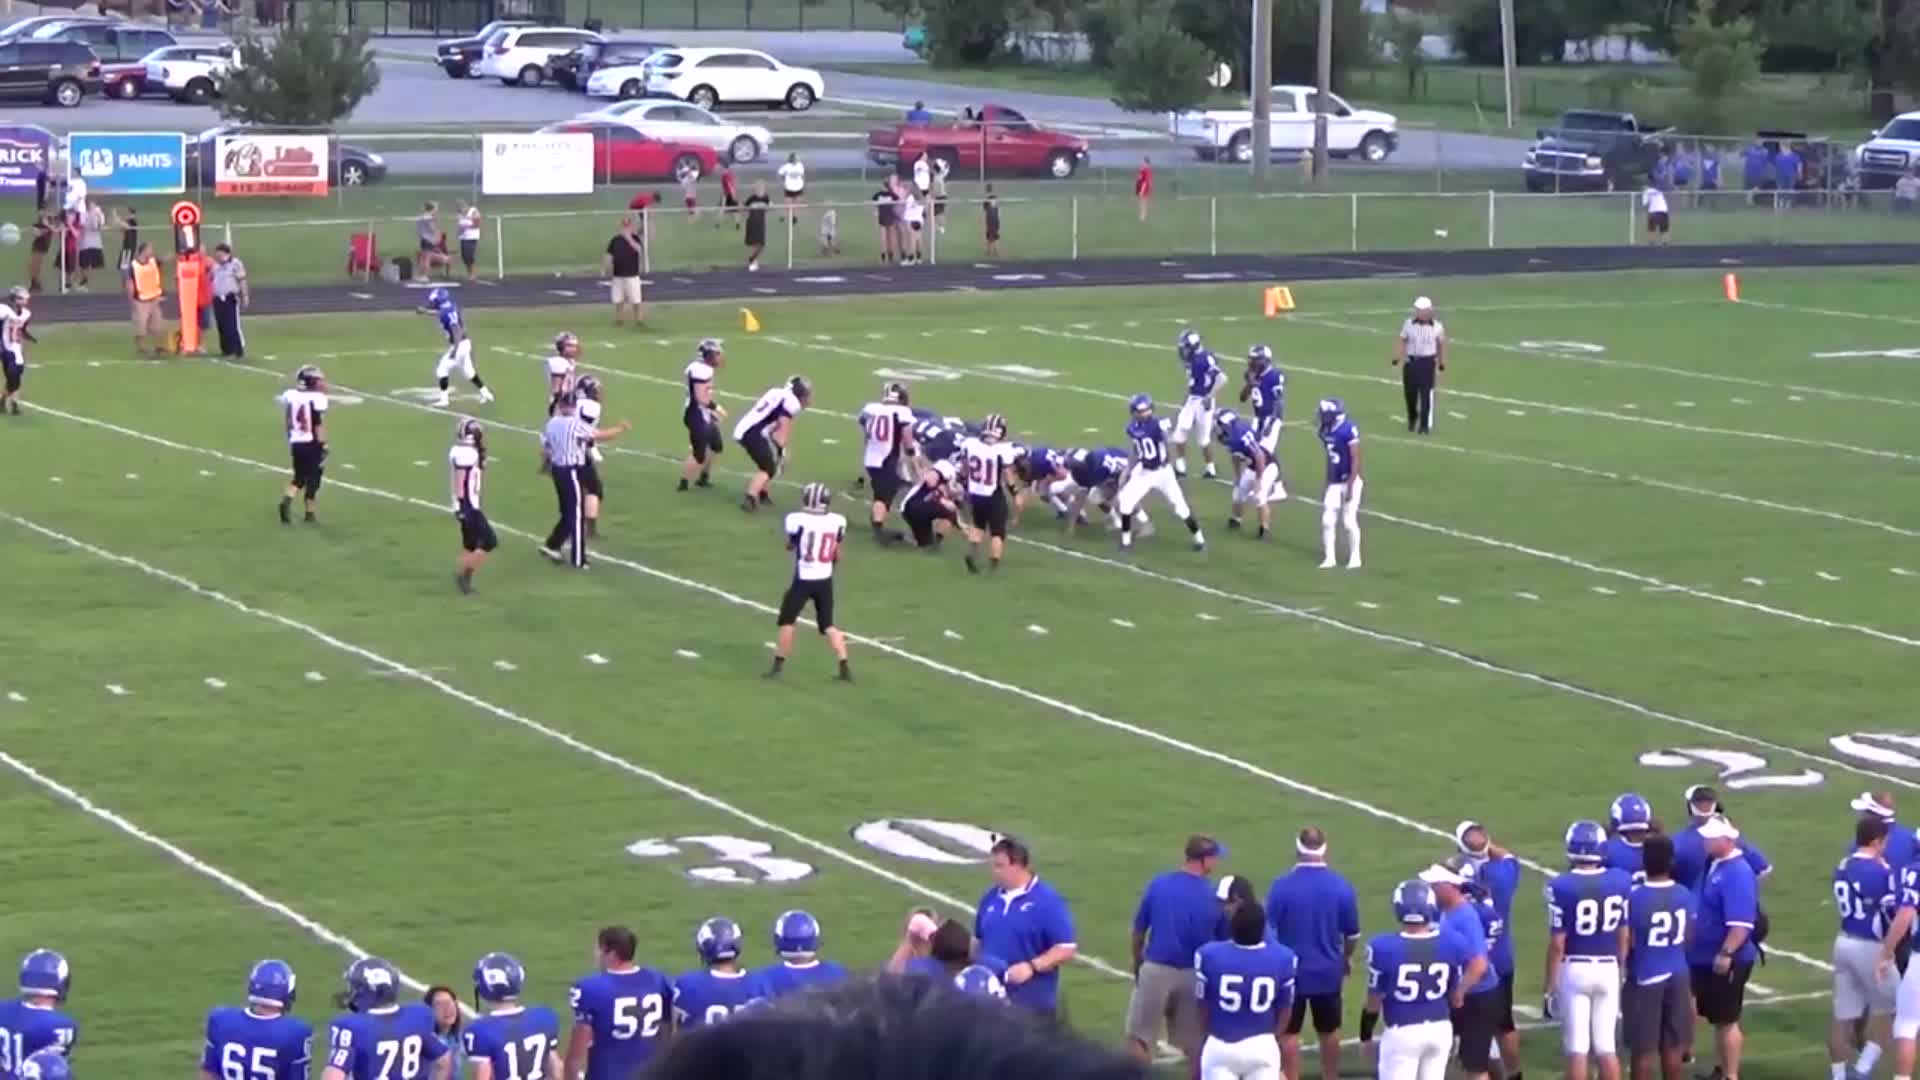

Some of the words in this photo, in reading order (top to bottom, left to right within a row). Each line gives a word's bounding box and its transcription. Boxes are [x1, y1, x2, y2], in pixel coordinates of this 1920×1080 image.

[119, 153, 173, 168] PAINTS
[969, 456, 994, 486] 21
[803, 531, 836, 563] 10
[1575, 895, 1623, 936] 86
[1834, 880, 1866, 919] 81
[1648, 909, 1687, 946] 21
[1219, 974, 1275, 1013] 50
[1393, 963, 1450, 1002] 53
[612, 993, 663, 1039] 52
[222, 1042, 278, 1080] 65
[376, 1034, 422, 1080] 78
[503, 1033, 548, 1080] 17
